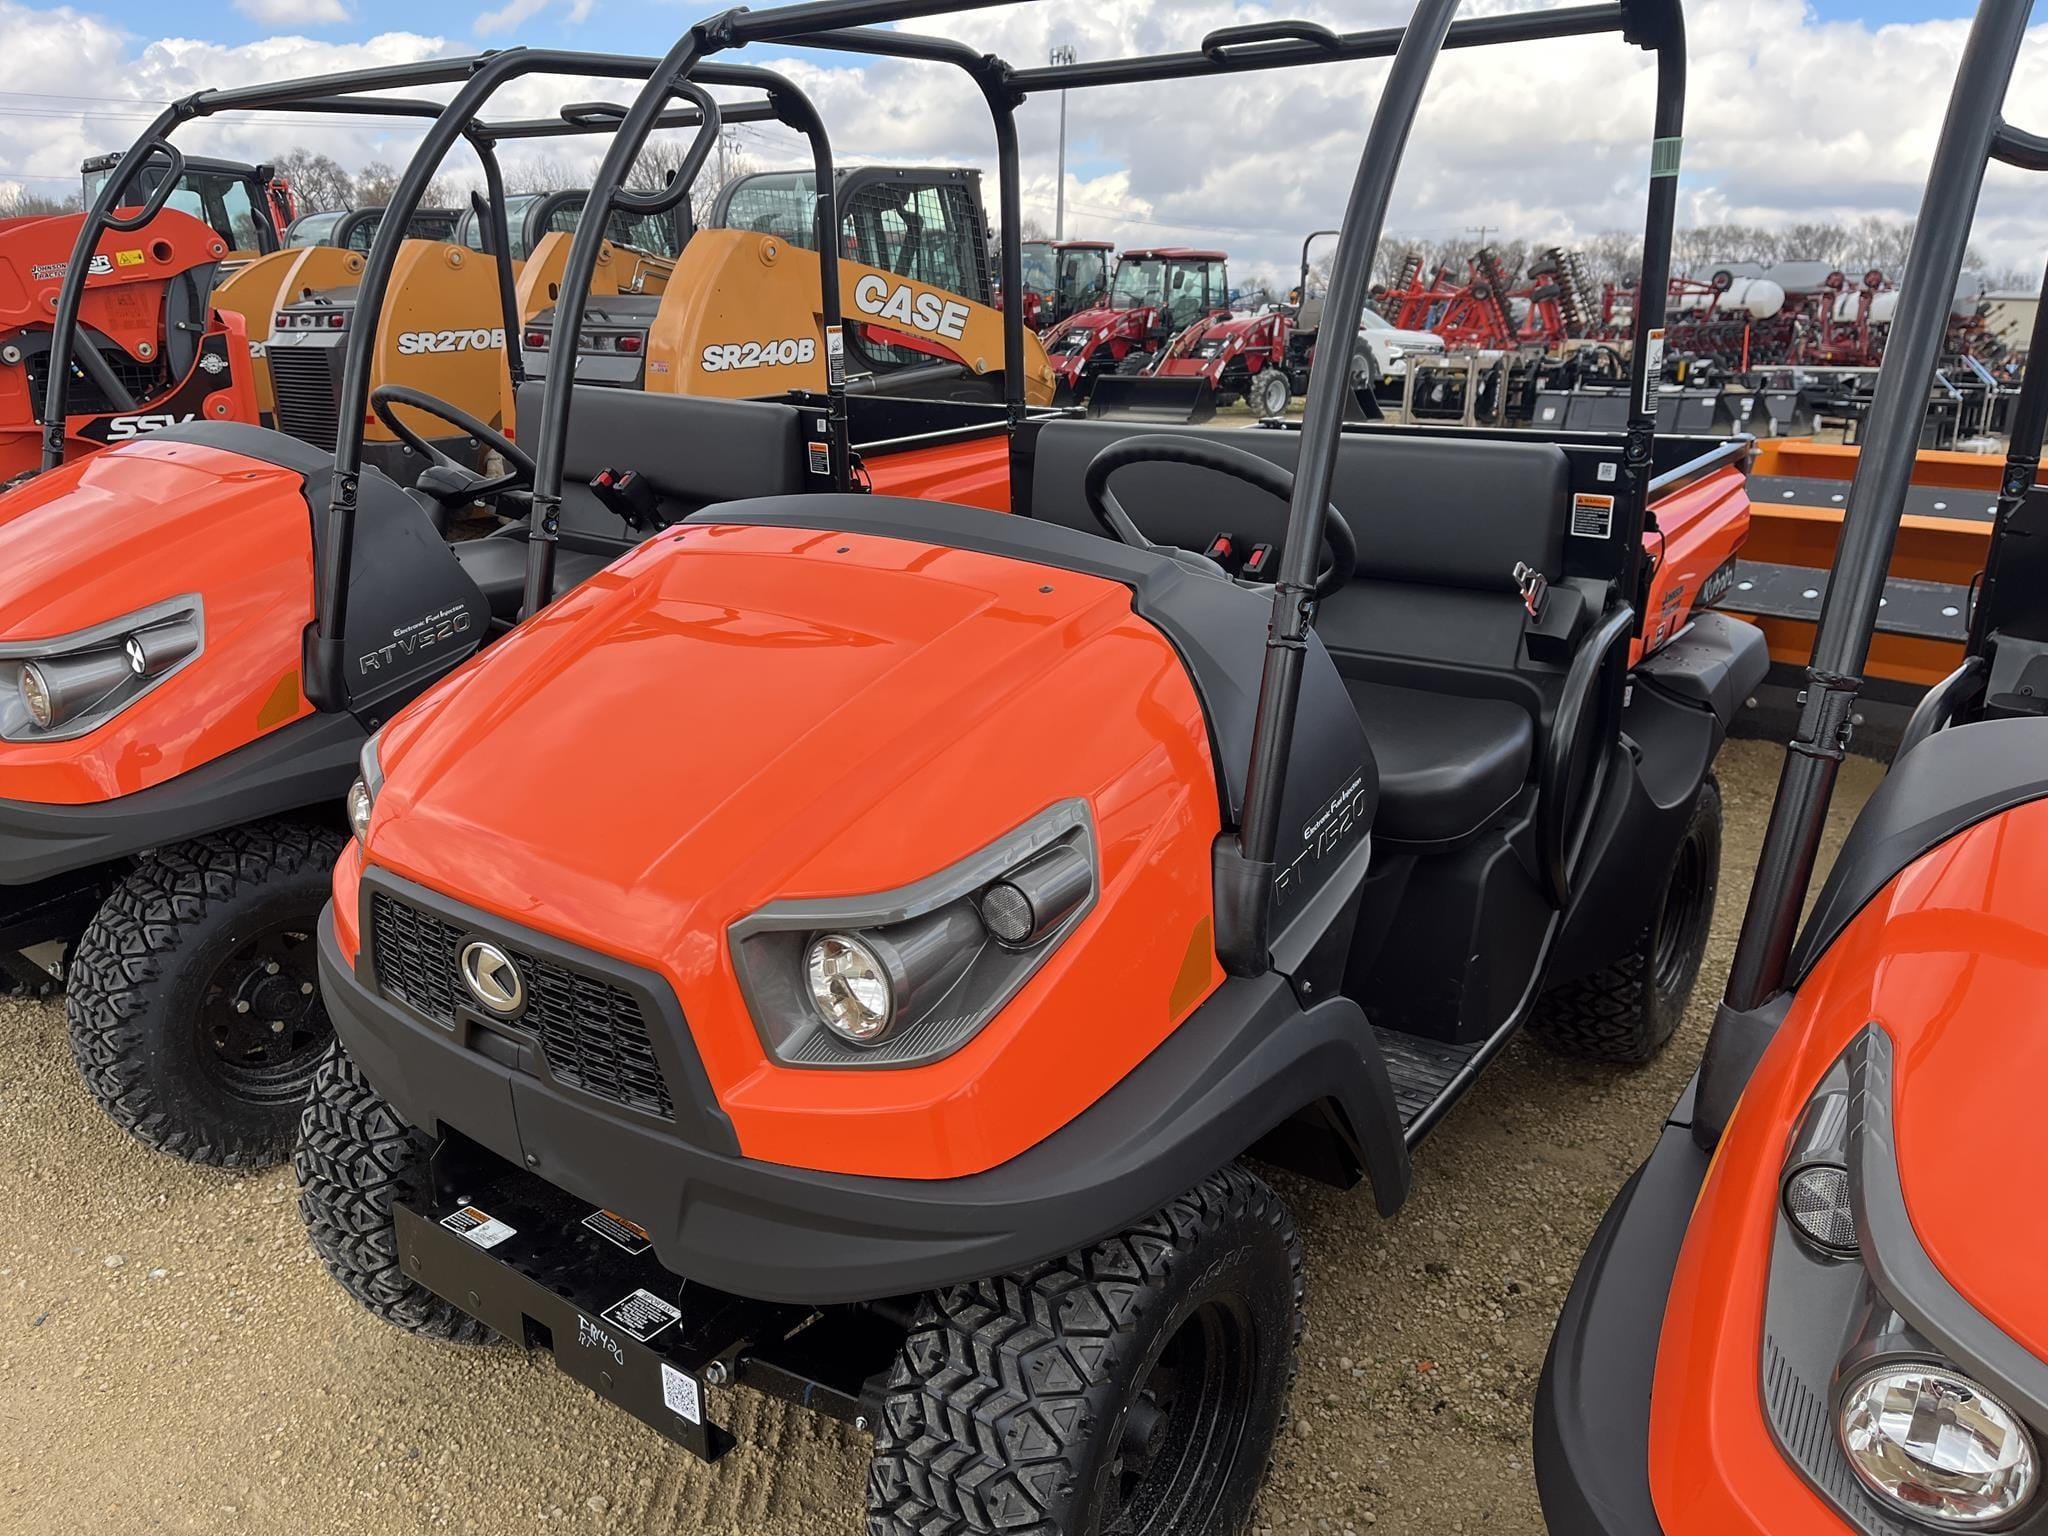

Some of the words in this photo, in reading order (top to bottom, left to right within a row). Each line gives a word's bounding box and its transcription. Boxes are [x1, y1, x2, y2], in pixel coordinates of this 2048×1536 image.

[31, 263, 67, 273] JOHNSON
[854, 273, 971, 341] CASE
[397, 328, 506, 355] SR270B
[701, 338, 816, 372] SR240B
[359, 611, 471, 675] RTV520
[393, 620, 425, 638] Electronic
